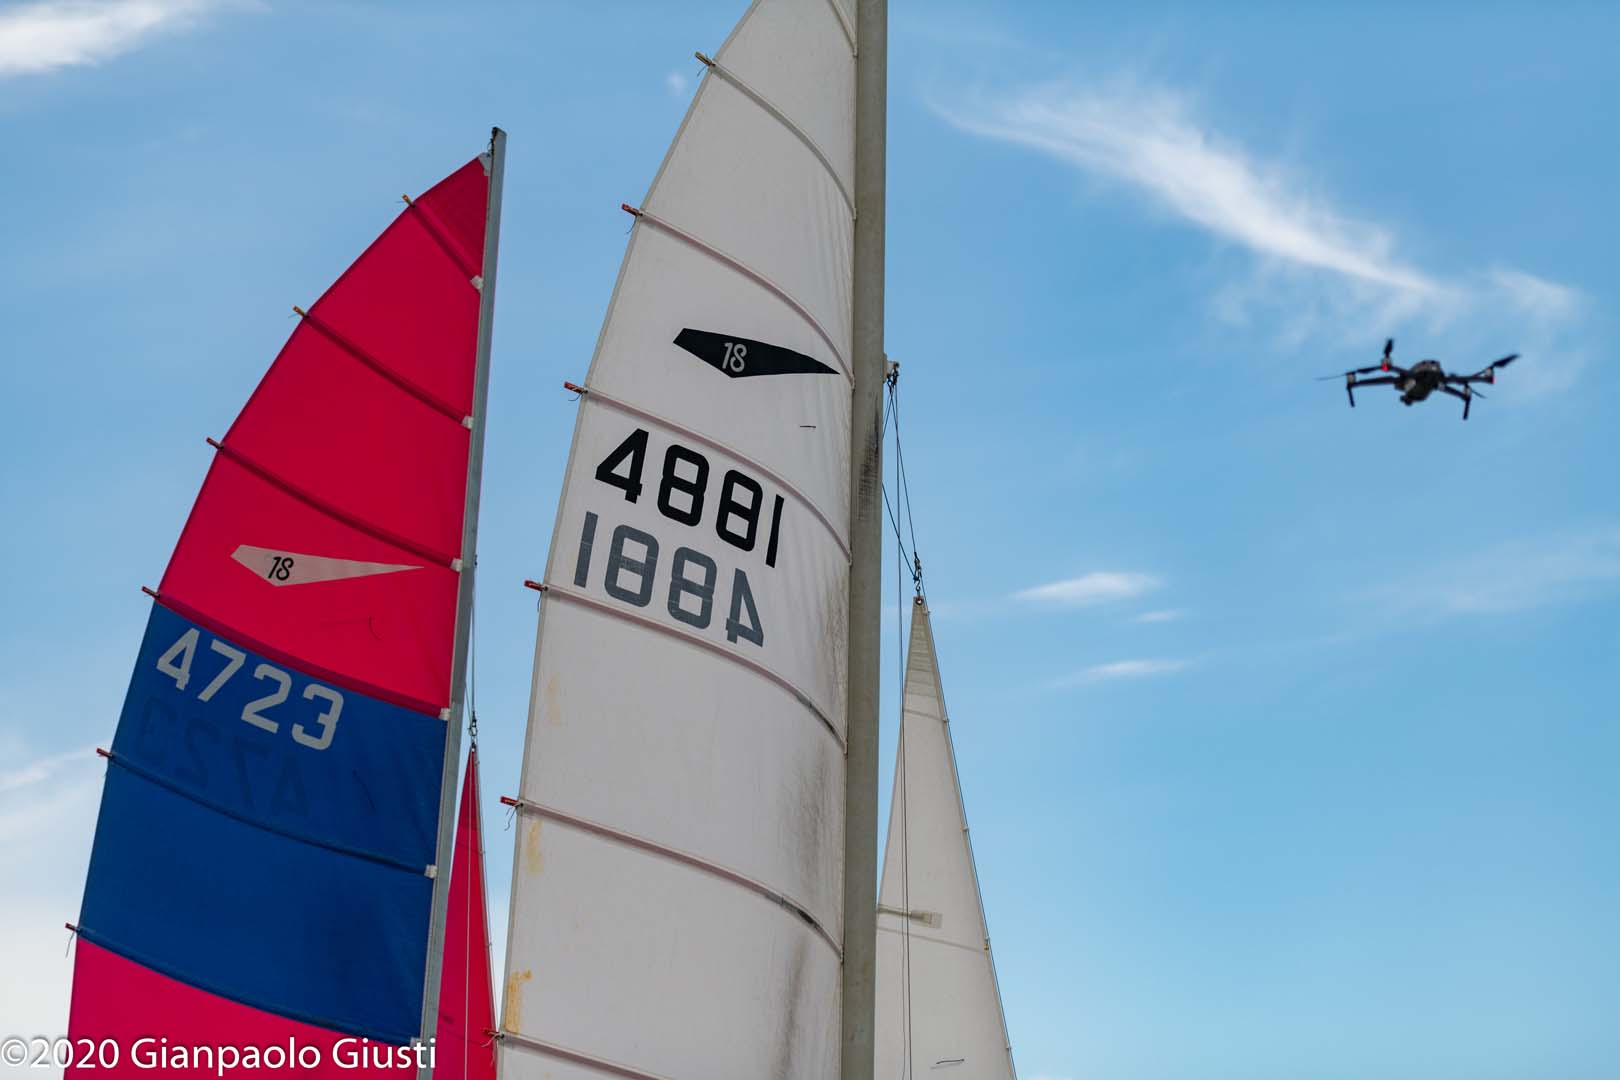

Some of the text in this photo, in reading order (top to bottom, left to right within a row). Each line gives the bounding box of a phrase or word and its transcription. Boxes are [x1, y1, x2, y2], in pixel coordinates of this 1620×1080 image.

[722, 343, 747, 373] 18
[595, 428, 784, 568] 4881
[267, 556, 294, 581] 18
[156, 628, 344, 750] 4723
